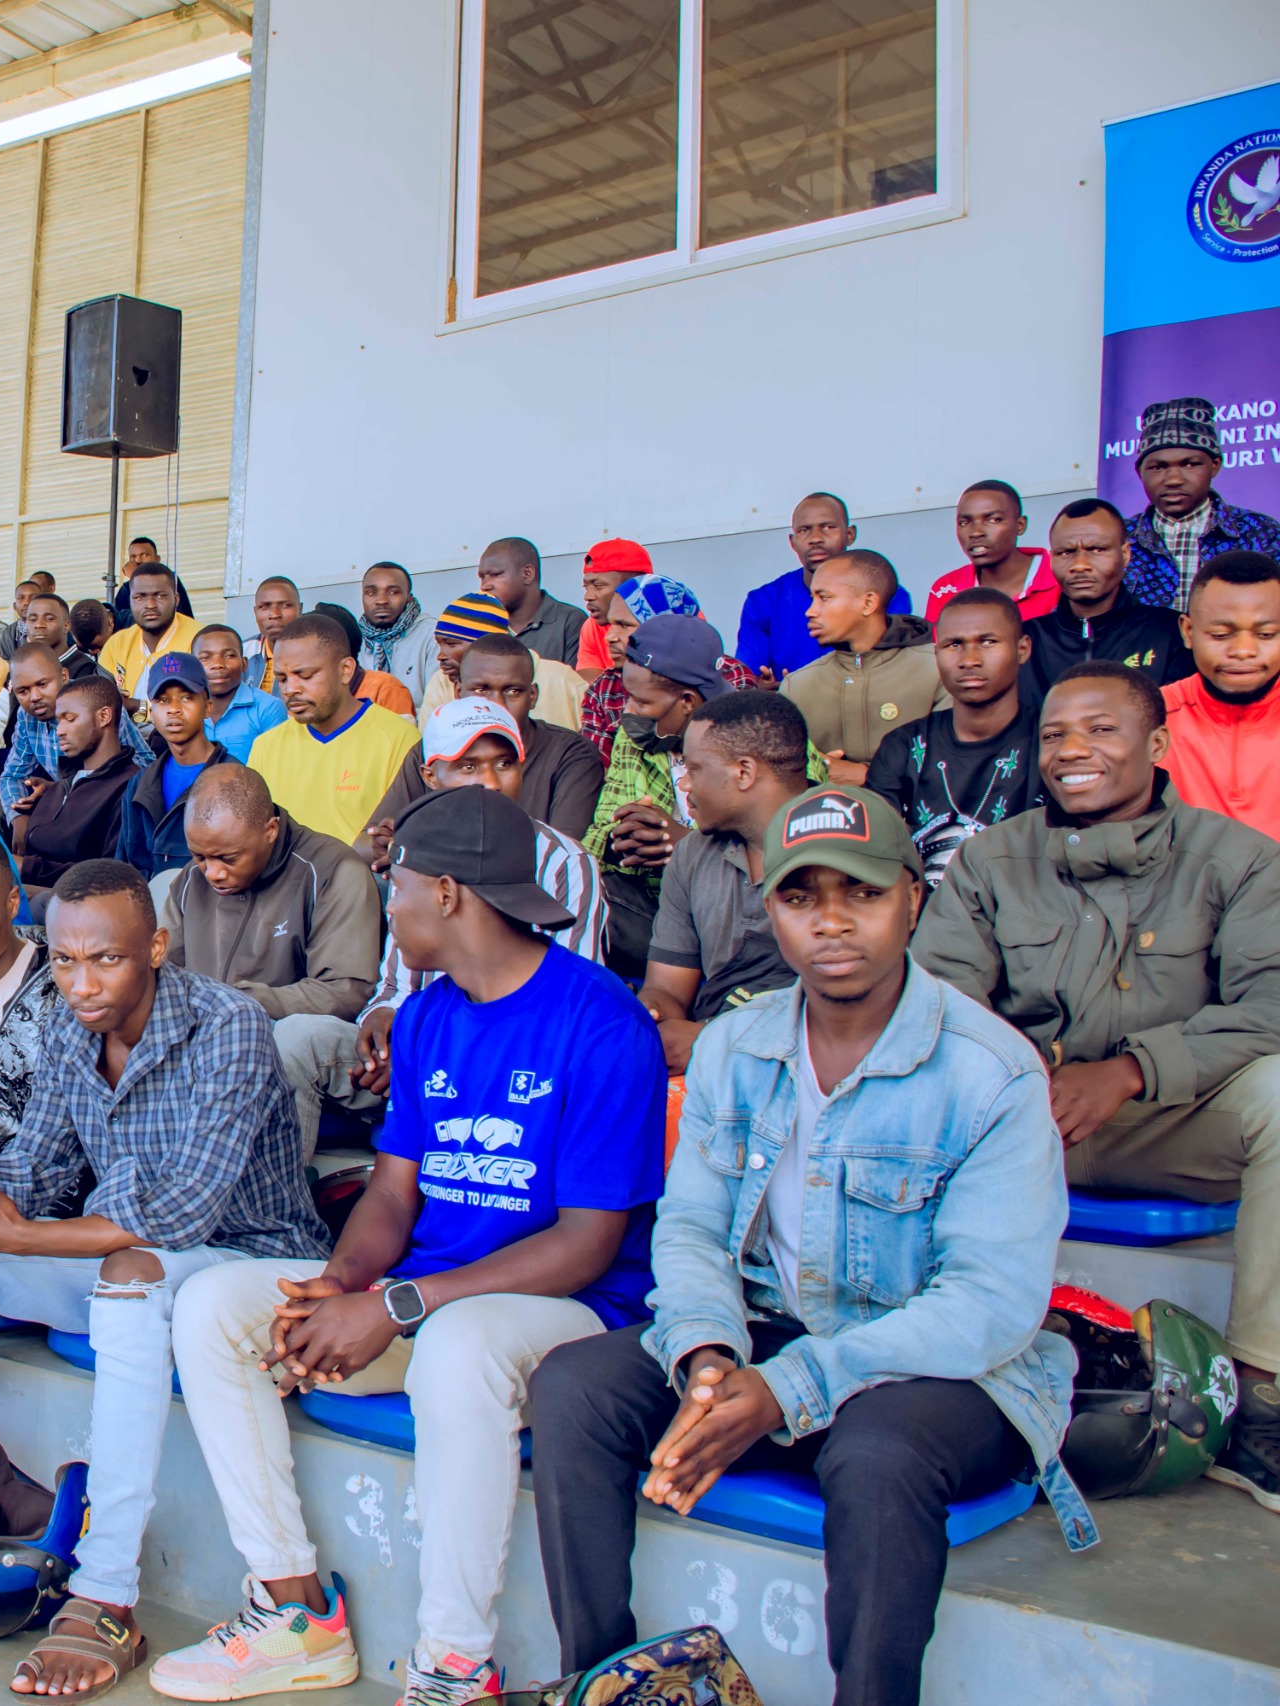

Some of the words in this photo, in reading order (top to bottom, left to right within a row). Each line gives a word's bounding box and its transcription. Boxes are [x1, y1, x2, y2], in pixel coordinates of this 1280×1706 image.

[1194, 151, 1234, 197] RWANDA
[1233, 244, 1279, 257] Protection
[466, 1191, 480, 1206] TO
[686, 1560, 817, 1656] 36
